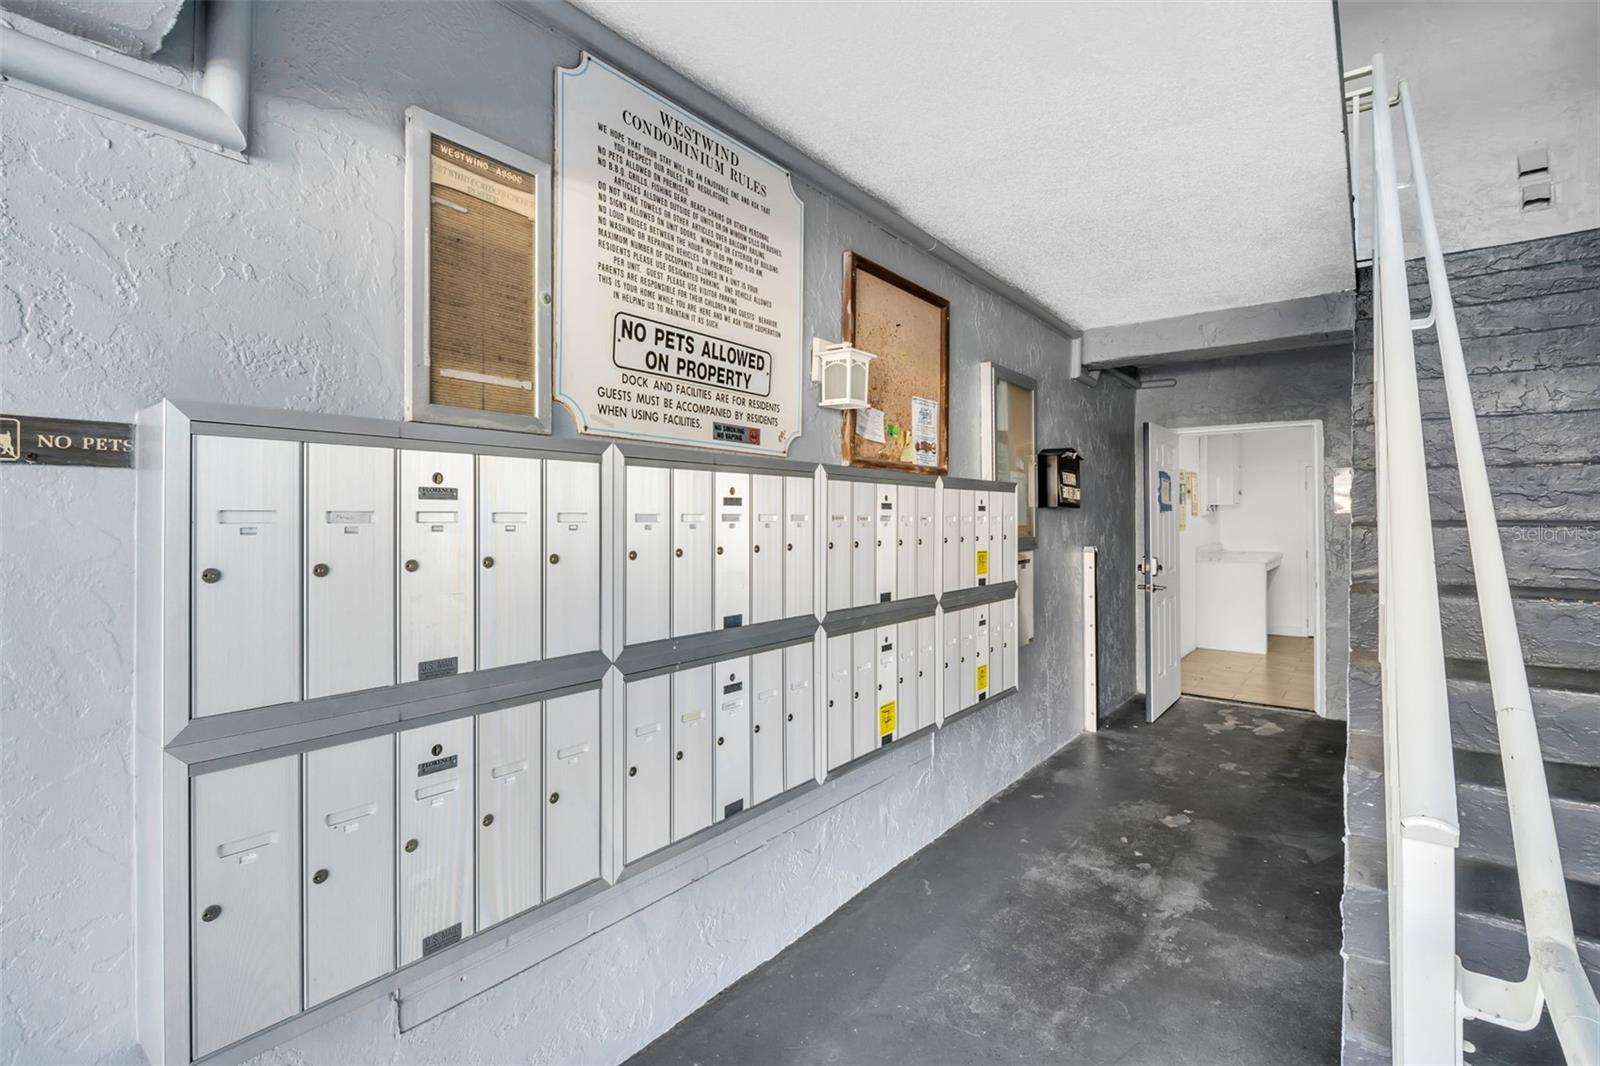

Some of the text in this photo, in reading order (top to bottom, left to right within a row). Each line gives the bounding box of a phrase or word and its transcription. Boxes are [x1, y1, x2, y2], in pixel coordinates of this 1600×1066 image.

[440, 144, 489, 170] WESTWIND
[597, 121, 606, 134] WE
[609, 127, 624, 143] HOPE
[627, 136, 640, 151] THAT
[643, 144, 657, 159] YOUR
[659, 152, 671, 166] STAY
[622, 110, 767, 198] CONDOMINIUM RULES
[660, 110, 739, 167] WESTWIND
[597, 145, 660, 182] NO PETS ALLOWED ON
[597, 156, 606, 169] NO
[651, 181, 671, 199] FISHING
[614, 141, 625, 154] YOU
[627, 148, 651, 167] RESPECT
[653, 161, 664, 173] OUR
[666, 167, 682, 182] RULES
[597, 180, 606, 192] DO
[608, 185, 620, 198] NOT
[622, 191, 637, 205] HANG
[640, 199, 661, 215] TOWELS
[663, 209, 671, 219] OR
[613, 175, 640, 195] ARTICLES
[643, 188, 667, 207] ALLOWED
[598, 192, 606, 203] NO
[609, 197, 626, 212] SIGNS
[629, 205, 655, 223] ALLOWED
[656, 216, 664, 227] ON
[666, 220, 677, 232] UNIT
[598, 203, 606, 215] NO
[609, 208, 624, 222] LOUD
[626, 215, 646, 231] NOISES
[649, 224, 674, 242] BETWEEN
[597, 215, 606, 226] NO
[609, 219, 635, 237] WASHING
[637, 231, 645, 241] OR
[647, 234, 674, 252] REPAIRING
[597, 227, 628, 246] MAXIMUM
[630, 239, 653, 256] NUMBER
[655, 249, 662, 259] OF
[664, 252, 693, 270] OCCUPANTS
[597, 238, 630, 258] RESIDENTS
[632, 251, 652, 266] PLEASE
[655, 259, 665, 270] USE
[613, 255, 624, 267] PER
[646, 267, 663, 280] GUEST
[666, 274, 685, 288] PLEASE
[597, 261, 624, 278] PARENTS
[626, 271, 637, 282] ARE
[640, 275, 675, 295] RESPONSIBLE
[598, 273, 611, 286] THIS
[623, 281, 637, 294] YOUR
[639, 287, 655, 299] HOME
[657, 292, 673, 305] WHILE
[613, 290, 619, 300] IN
[621, 292, 644, 307] HELPING
[647, 300, 654, 310] US
[656, 303, 663, 313] TO
[665, 306, 689, 320] MAINTAIN
[621, 318, 764, 372] NO PETS ALLOWED
[645, 349, 750, 390] ON PROPERTY
[597, 385, 778, 427] GUESTS MUST BE ACCOMPANIED BY RESIDENTS
[621, 373, 779, 413] DOCK AND FACILITIES ARE FOR RESIDENTS
[597, 402, 701, 430] WHEN USING FACILITIES.
[37, 434, 134, 452] NO PETS
